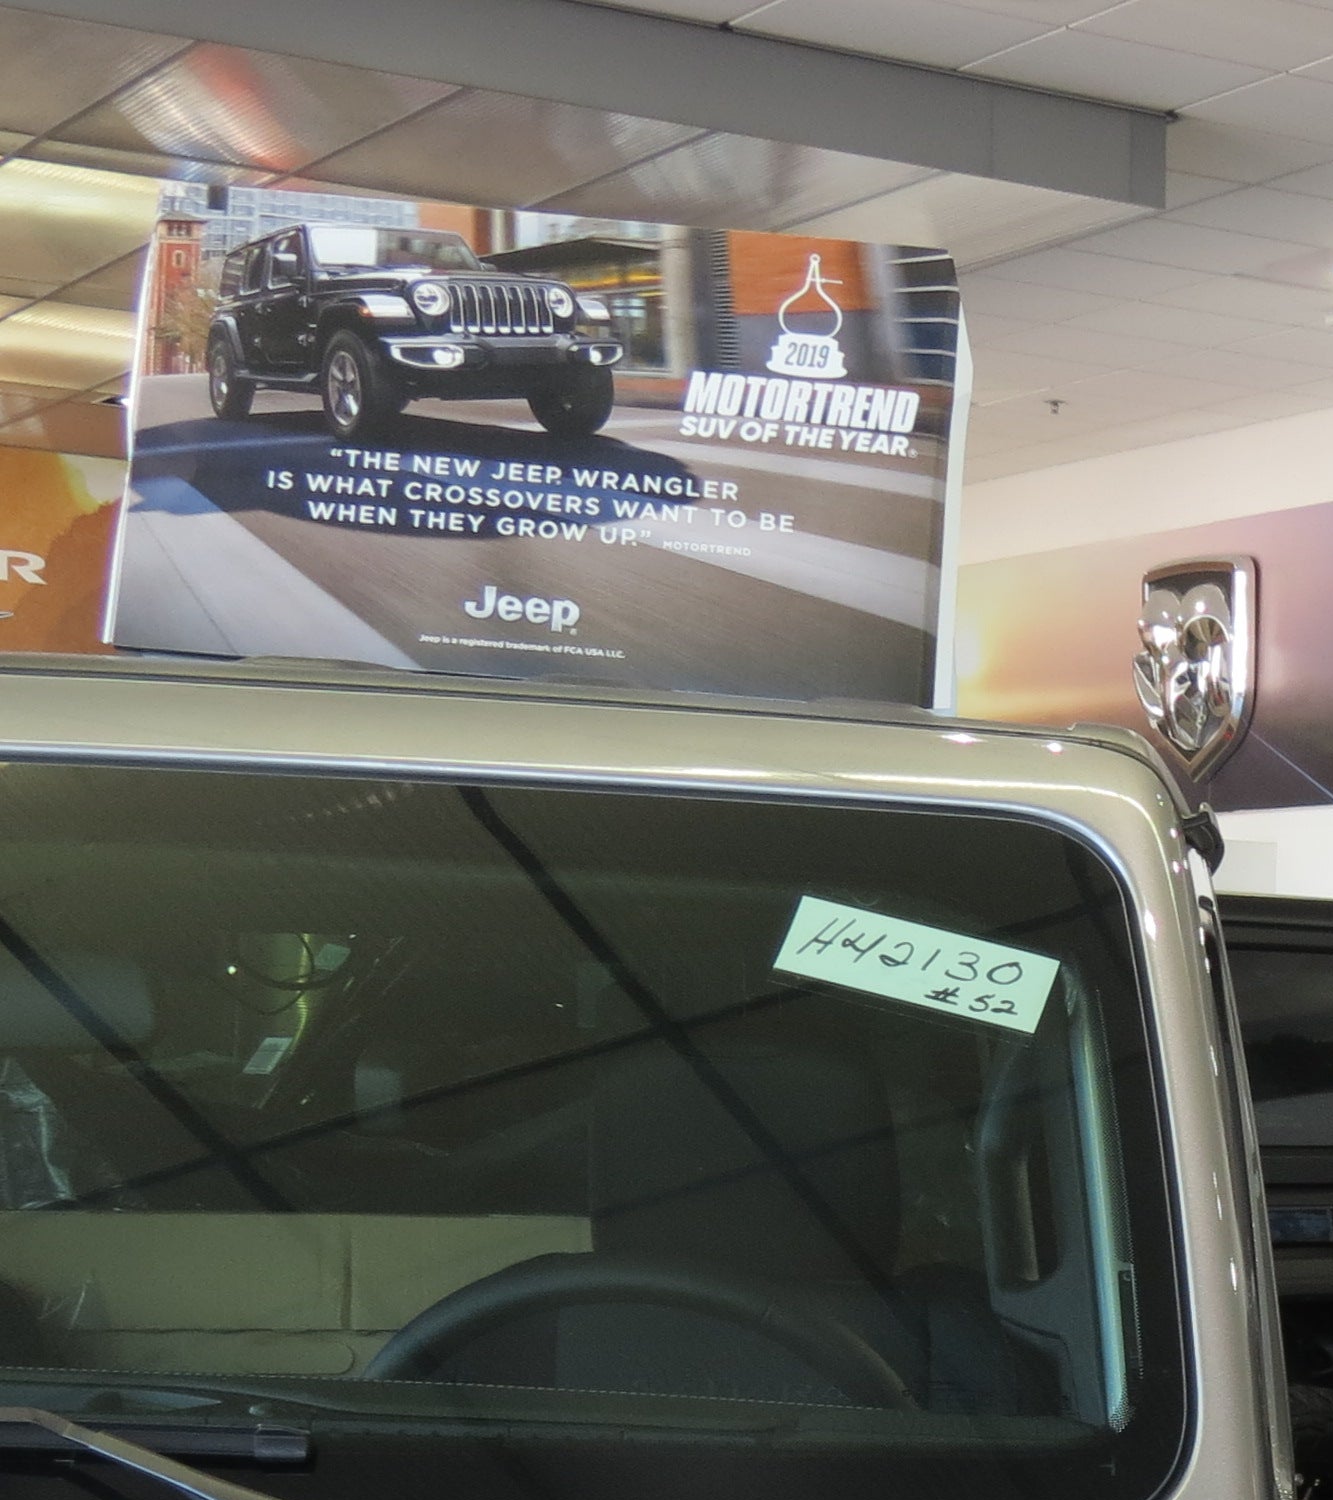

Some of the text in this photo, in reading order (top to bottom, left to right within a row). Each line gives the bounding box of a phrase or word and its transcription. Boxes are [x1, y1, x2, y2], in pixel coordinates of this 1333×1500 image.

[784, 342, 829, 368] 2019
[684, 371, 920, 433] MOTORTREND
[680, 416, 737, 440] SUV
[740, 420, 779, 443] OF
[783, 425, 838, 449] THE
[330, 448, 401, 472] “THE
[412, 454, 480, 478] NEW
[572, 468, 739, 501] WRANGLER
[266, 470, 795, 533] IS WHAT CROSSOVERS WANT TO BE
[308, 501, 397, 526] WHEN
[409, 509, 486, 533] THEY
[496, 517, 588, 542] GROW
[663, 540, 752, 557] MOTORTREND
[464, 585, 580, 632] Jeep
[418, 634, 441, 644] Jeep
[459, 638, 504, 648] registered
[505, 641, 551, 652] trademark
[552, 645, 563, 653] of
[563, 646, 583, 655] FCA
[584, 648, 604, 657] USA
[796, 917, 1024, 985] H42130
